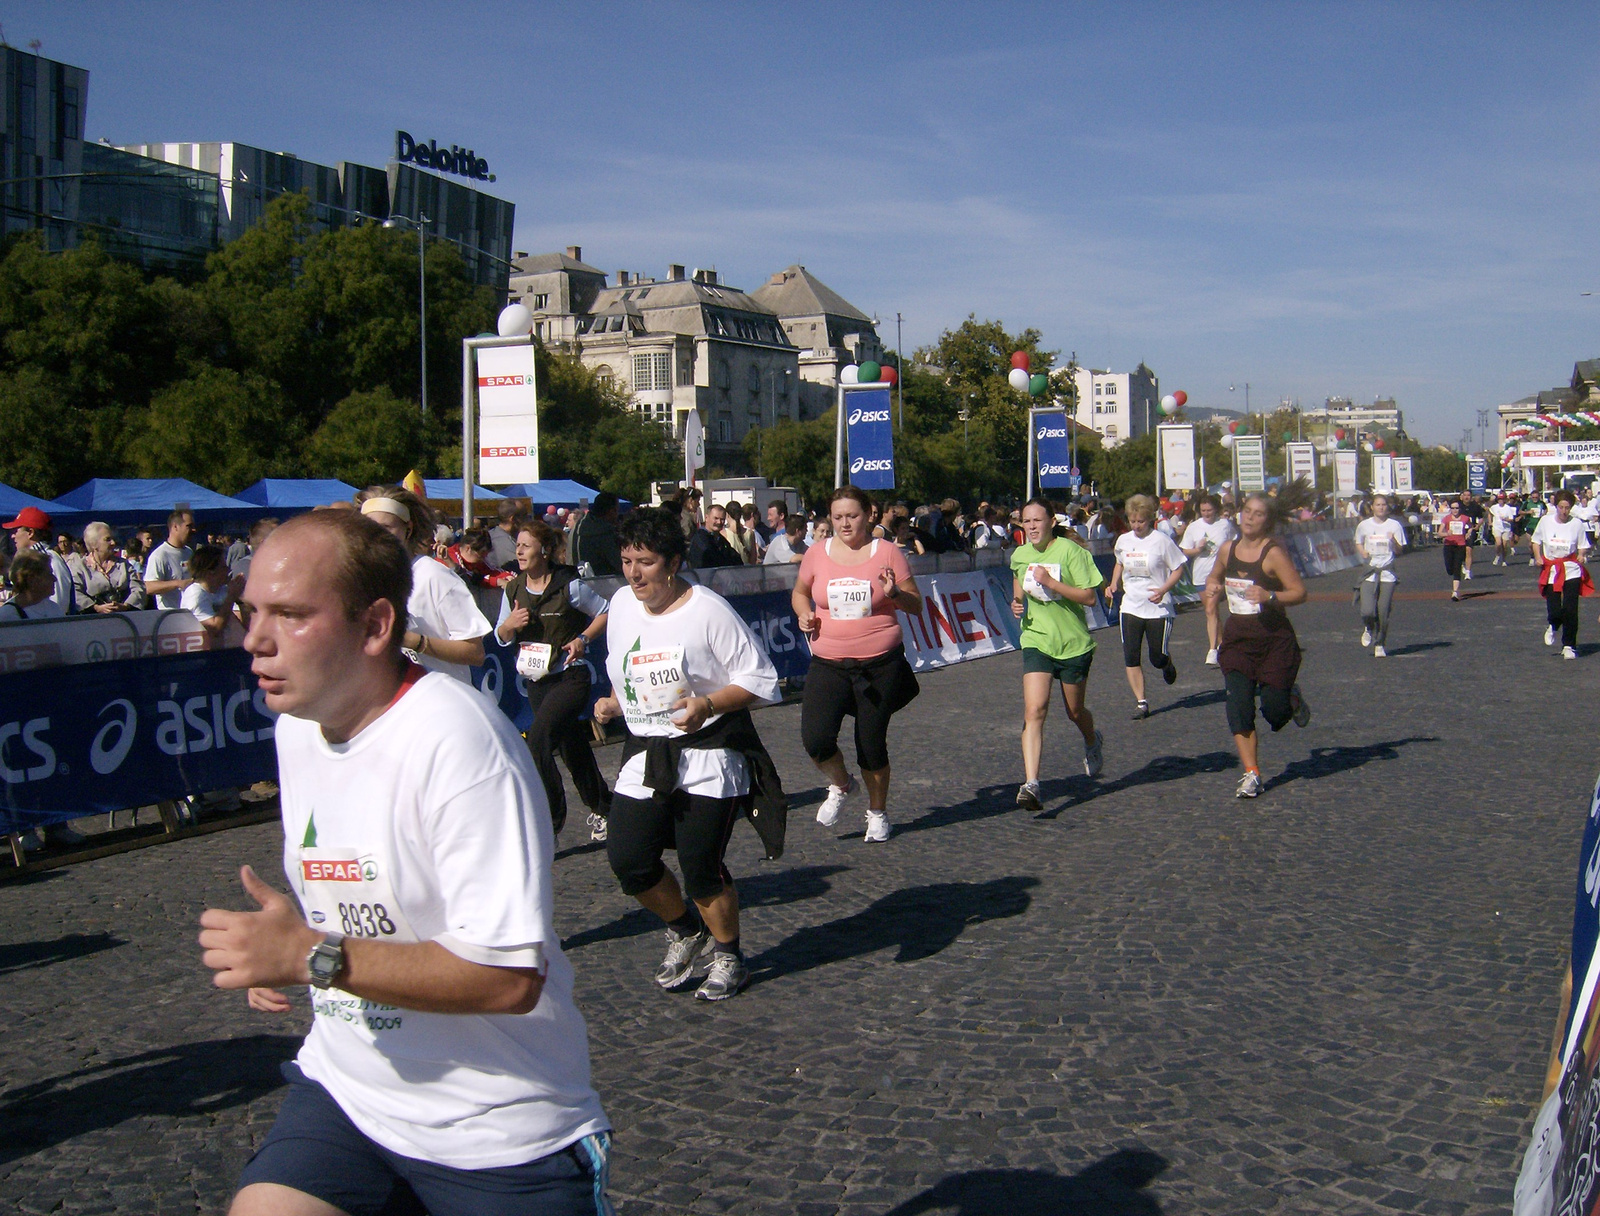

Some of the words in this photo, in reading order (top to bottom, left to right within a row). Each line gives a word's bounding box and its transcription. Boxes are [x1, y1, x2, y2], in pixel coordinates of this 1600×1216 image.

[487, 377, 523, 386] SPAR
[489, 448, 527, 457] SPAR
[843, 591, 867, 601] 7407
[527, 656, 546, 669] 8981
[637, 653, 671, 664] SPAR
[649, 667, 680, 686] 8120
[310, 863, 361, 879] SPAR
[338, 902, 397, 938] 8938
[367, 1016, 403, 1030] 2009
